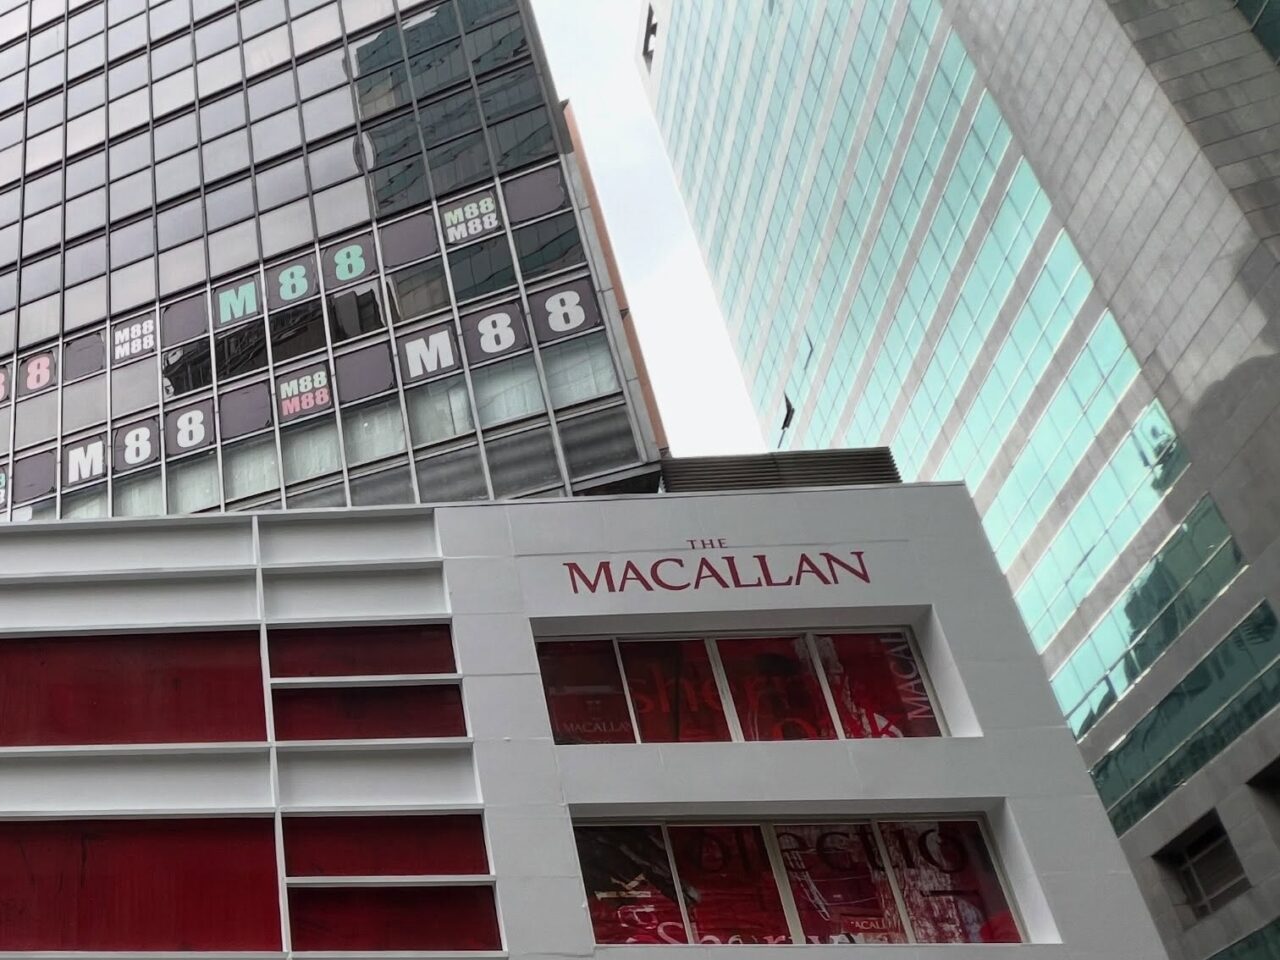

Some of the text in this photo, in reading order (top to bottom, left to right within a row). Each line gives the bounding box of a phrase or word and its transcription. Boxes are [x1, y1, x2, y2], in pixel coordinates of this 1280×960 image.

[443, 196, 496, 226] M88
[447, 213, 499, 241] M88
[114, 319, 154, 344] M88
[114, 334, 155, 360] M88
[279, 370, 328, 399] M88
[282, 387, 331, 416] M88
[686, 538, 728, 550] THE
[562, 551, 871, 594] MACALLAN
